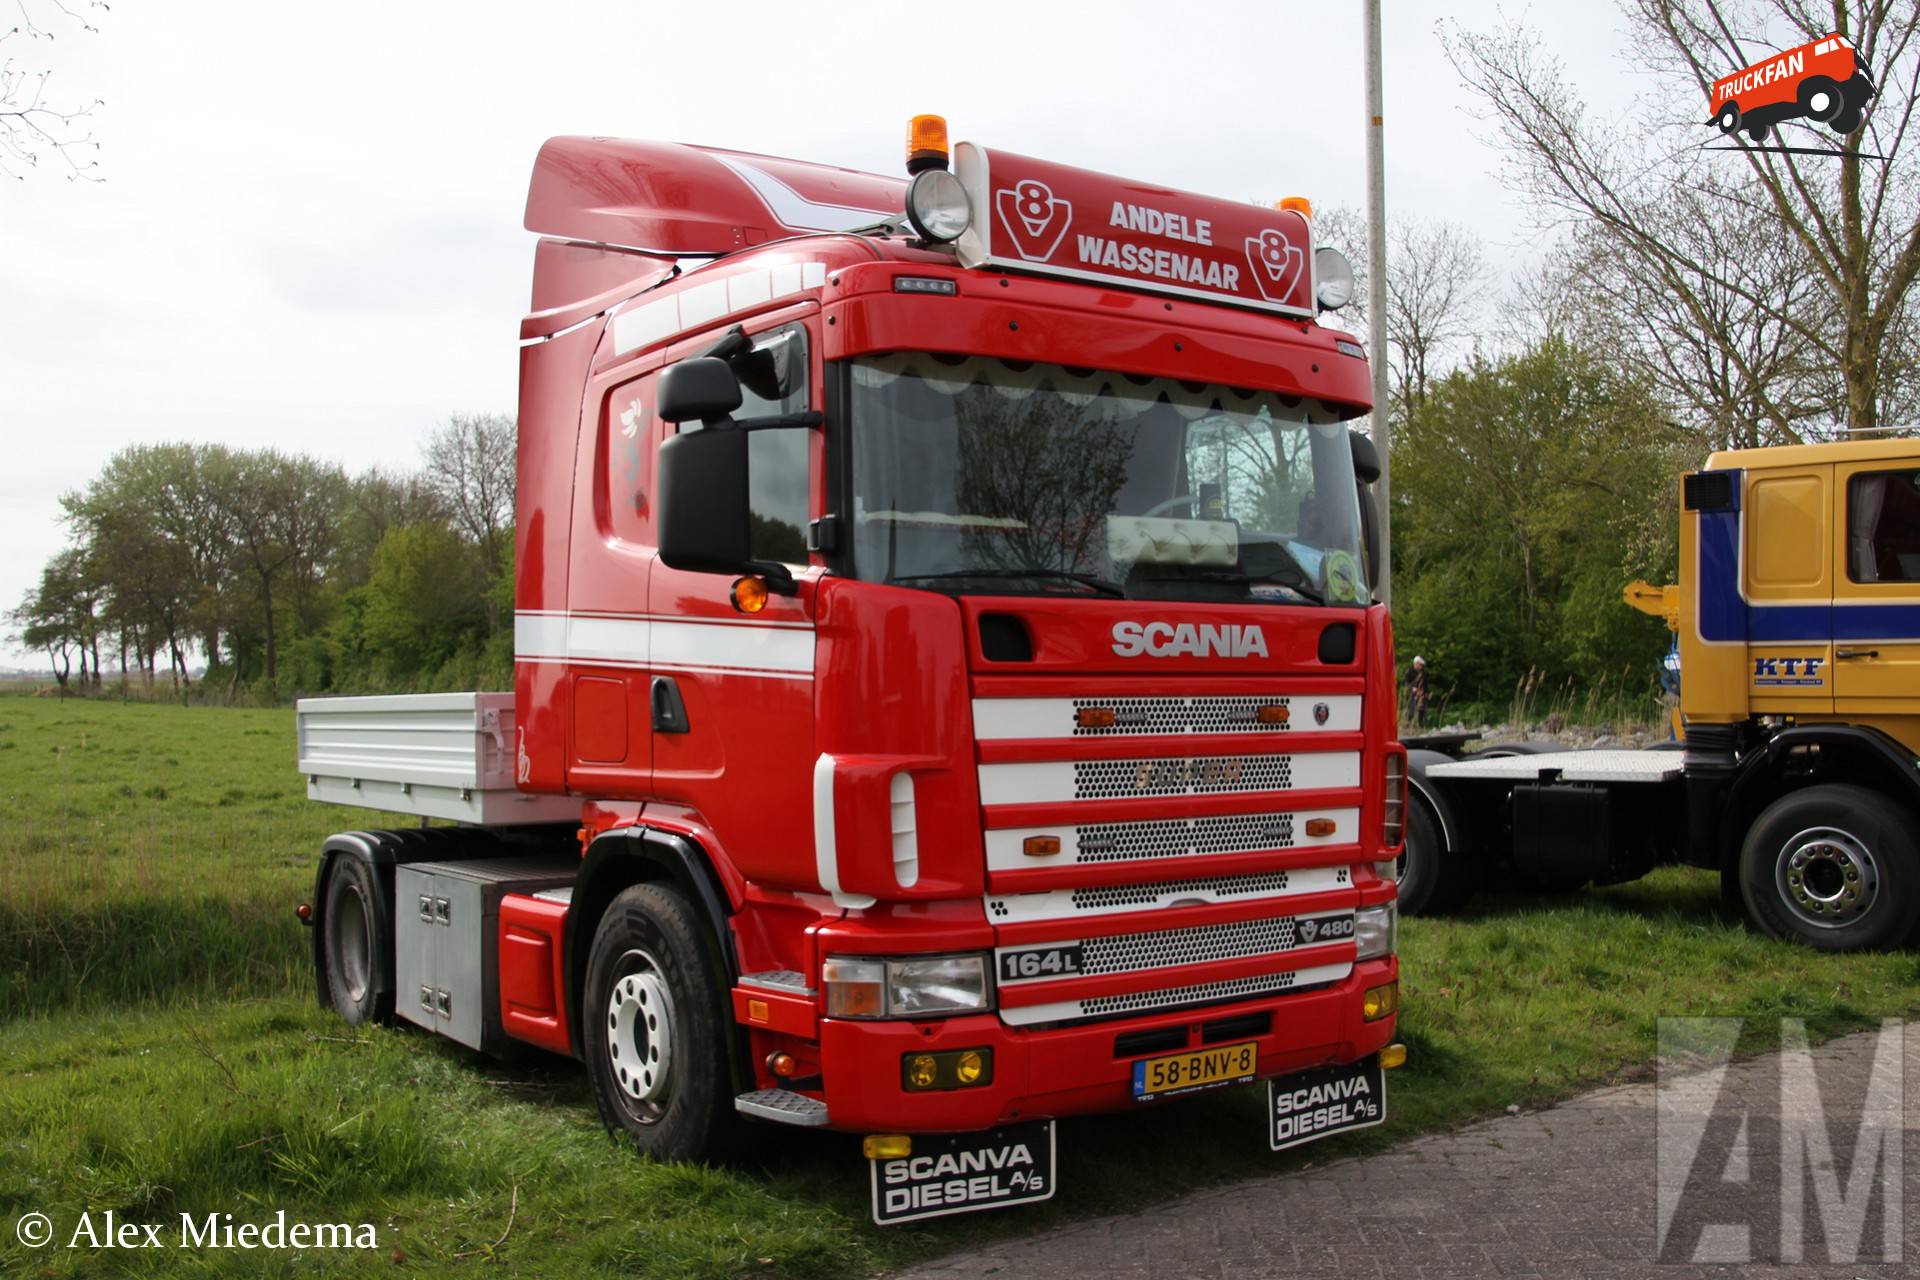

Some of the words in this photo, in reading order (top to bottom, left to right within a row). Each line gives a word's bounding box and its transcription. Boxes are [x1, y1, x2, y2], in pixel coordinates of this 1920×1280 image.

[1109, 201, 1213, 246] ANDELE
[1077, 234, 1240, 291] WASSENAAR
[1111, 620, 1270, 658] SCANIA
[1754, 658, 1825, 676] KTF
[1320, 919, 1354, 937] 480
[1152, 1048, 1251, 1087] 58-BNV-8
[1277, 1075, 1371, 1115] SCANVA
[1277, 1103, 1355, 1140] DIESEL
[884, 1143, 1034, 1184] SCANVA
[885, 1175, 1011, 1214] DIESEL
